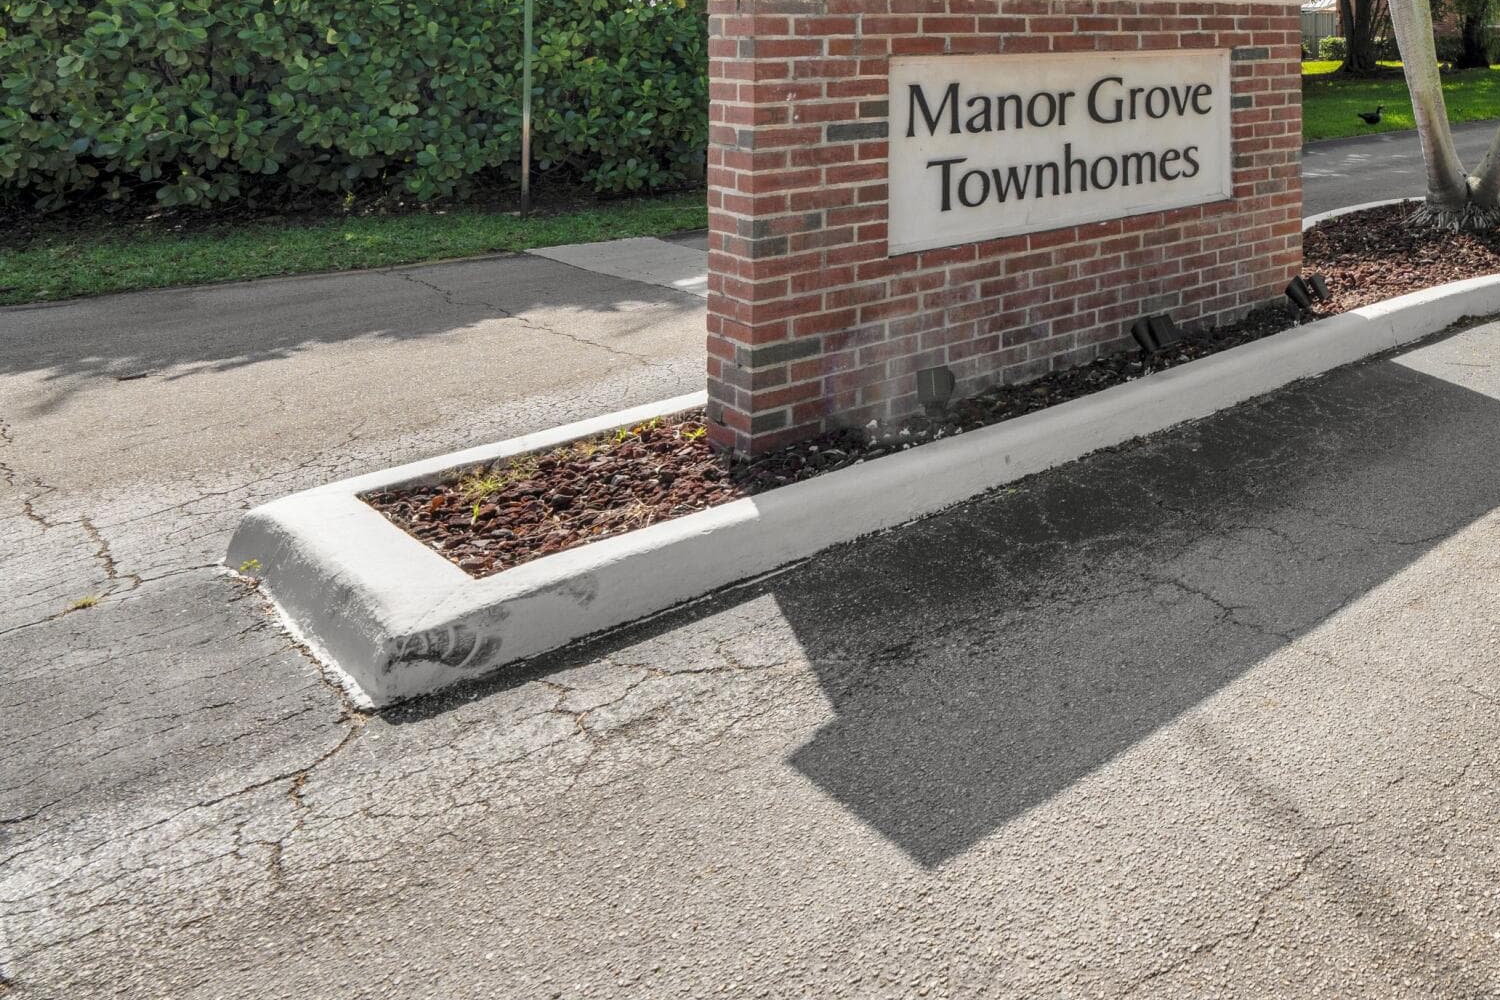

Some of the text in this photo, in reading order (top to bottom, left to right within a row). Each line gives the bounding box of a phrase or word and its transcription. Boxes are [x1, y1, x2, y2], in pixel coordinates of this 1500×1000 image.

[905, 76, 1213, 138] Manor Grove
[926, 142, 1200, 212] Townhomes
